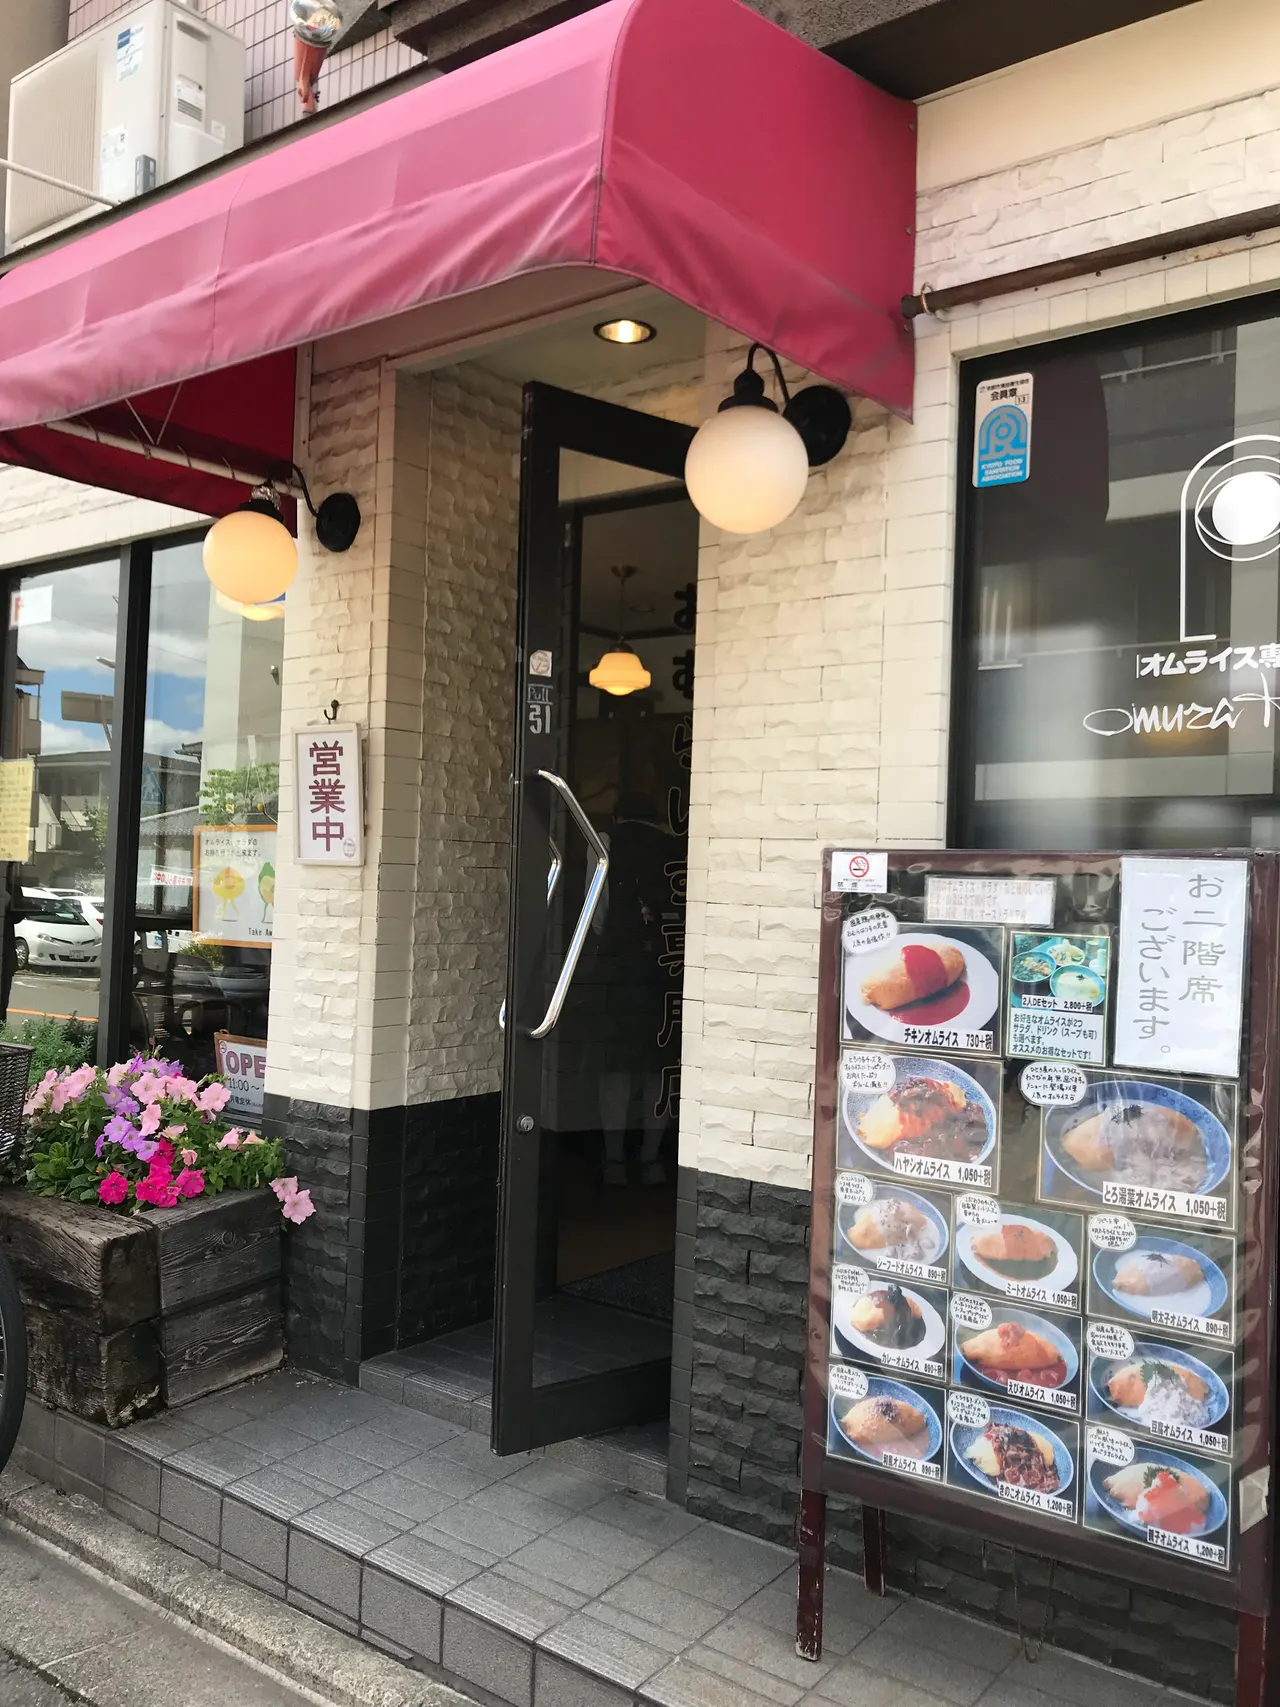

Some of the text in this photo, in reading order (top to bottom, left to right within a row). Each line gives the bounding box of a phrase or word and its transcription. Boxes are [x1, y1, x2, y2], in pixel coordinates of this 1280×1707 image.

[309, 740, 346, 852] 営業中
[248, 927, 262, 936] Take
[1178, 874, 1228, 1003] お二階席
[1133, 906, 1177, 1054] ございます。
[904, 1028, 959, 1047] チキンオムライス
[895, 1157, 950, 1179] ハヤシオムライス
[1104, 1185, 1176, 1212] とろ湯葉オムライス
[877, 1258, 923, 1277] シーフードオムライス
[1007, 1283, 1047, 1301] ミートオムライス
[1152, 1310, 1200, 1331] 明太子オムライス
[882, 1353, 920, 1371] カレーオムライス
[1008, 1381, 1046, 1401] えびオムライス
[1151, 1419, 1193, 1442] 豆腐オムライス
[883, 1454, 917, 1473] 和風オムライス
[999, 1485, 1041, 1507] きのこオムライス
